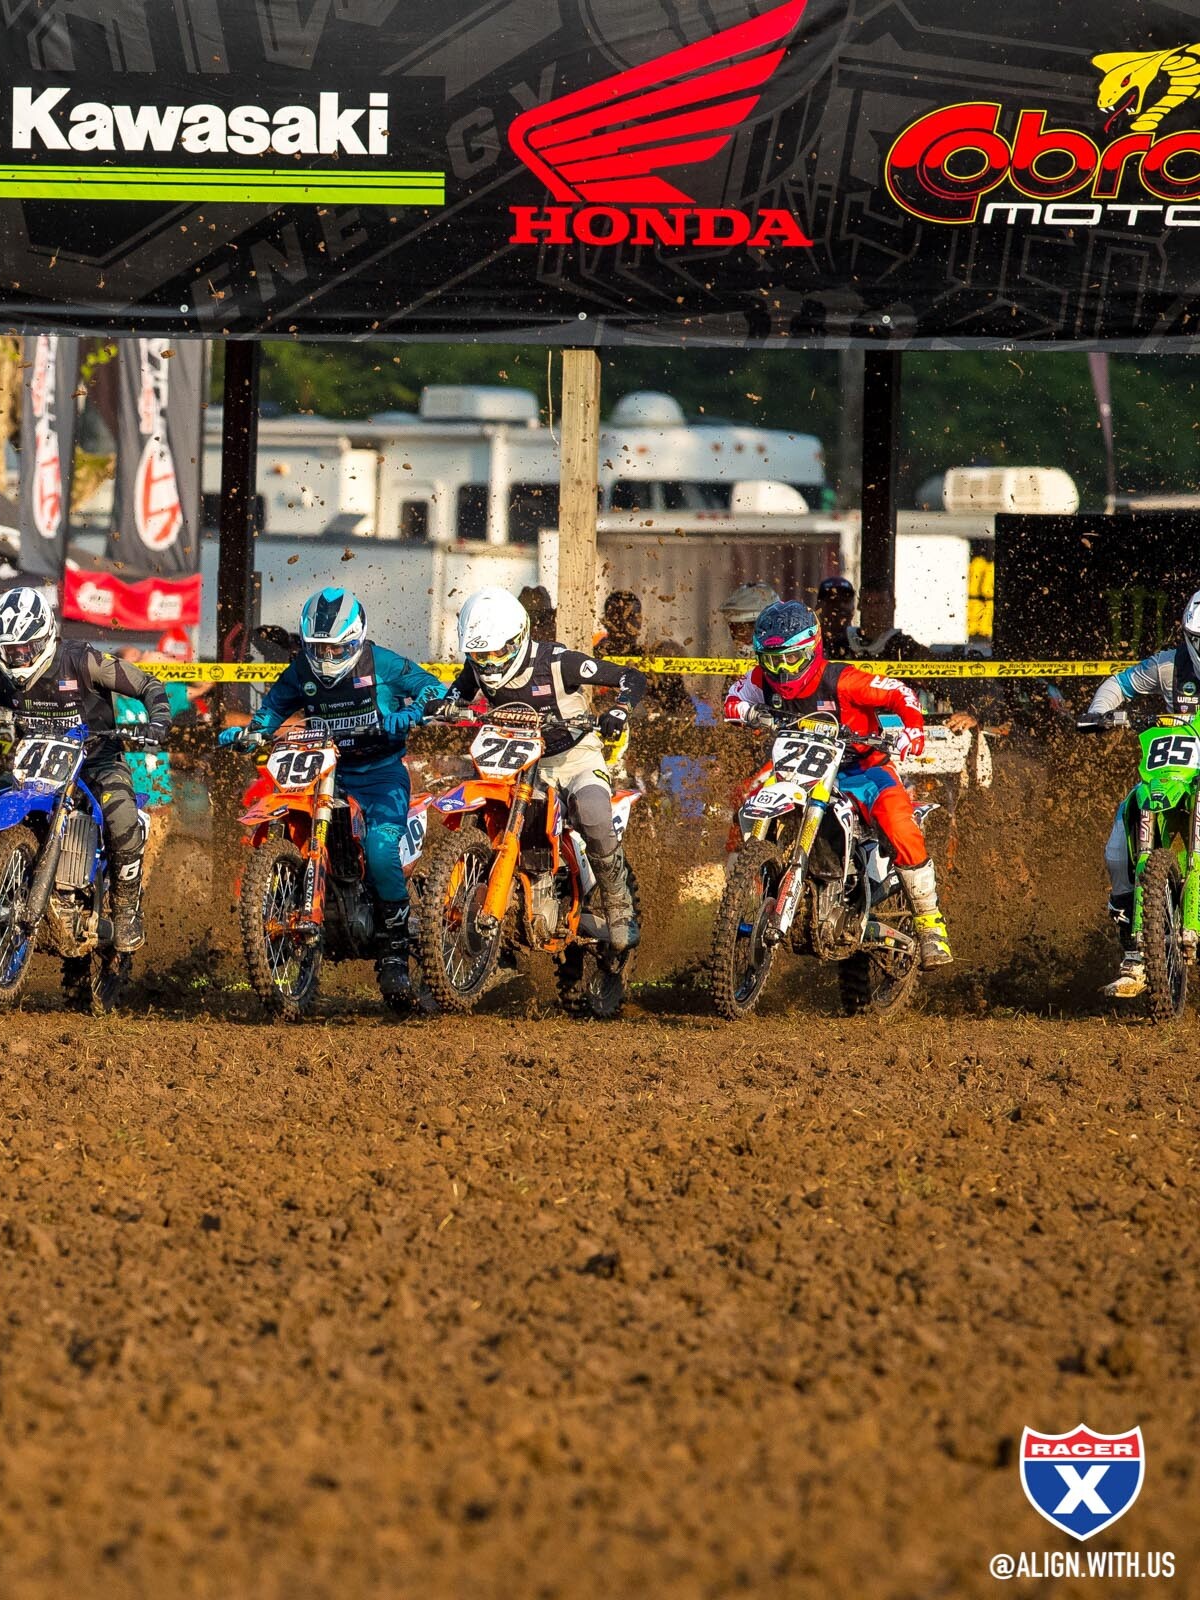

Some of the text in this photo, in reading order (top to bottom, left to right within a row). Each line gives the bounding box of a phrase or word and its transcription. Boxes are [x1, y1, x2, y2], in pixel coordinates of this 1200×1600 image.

[11, 86, 389, 156] Kawasaki
[508, 205, 814, 247] HONDA
[311, 712, 377, 730] CHAMPIONSHIP
[493, 711, 543, 722] RENTHAL
[16, 742, 79, 781] 48
[275, 750, 325, 785] 19
[474, 737, 536, 769] 26
[774, 740, 837, 778] 28
[1146, 736, 1196, 770] 85
